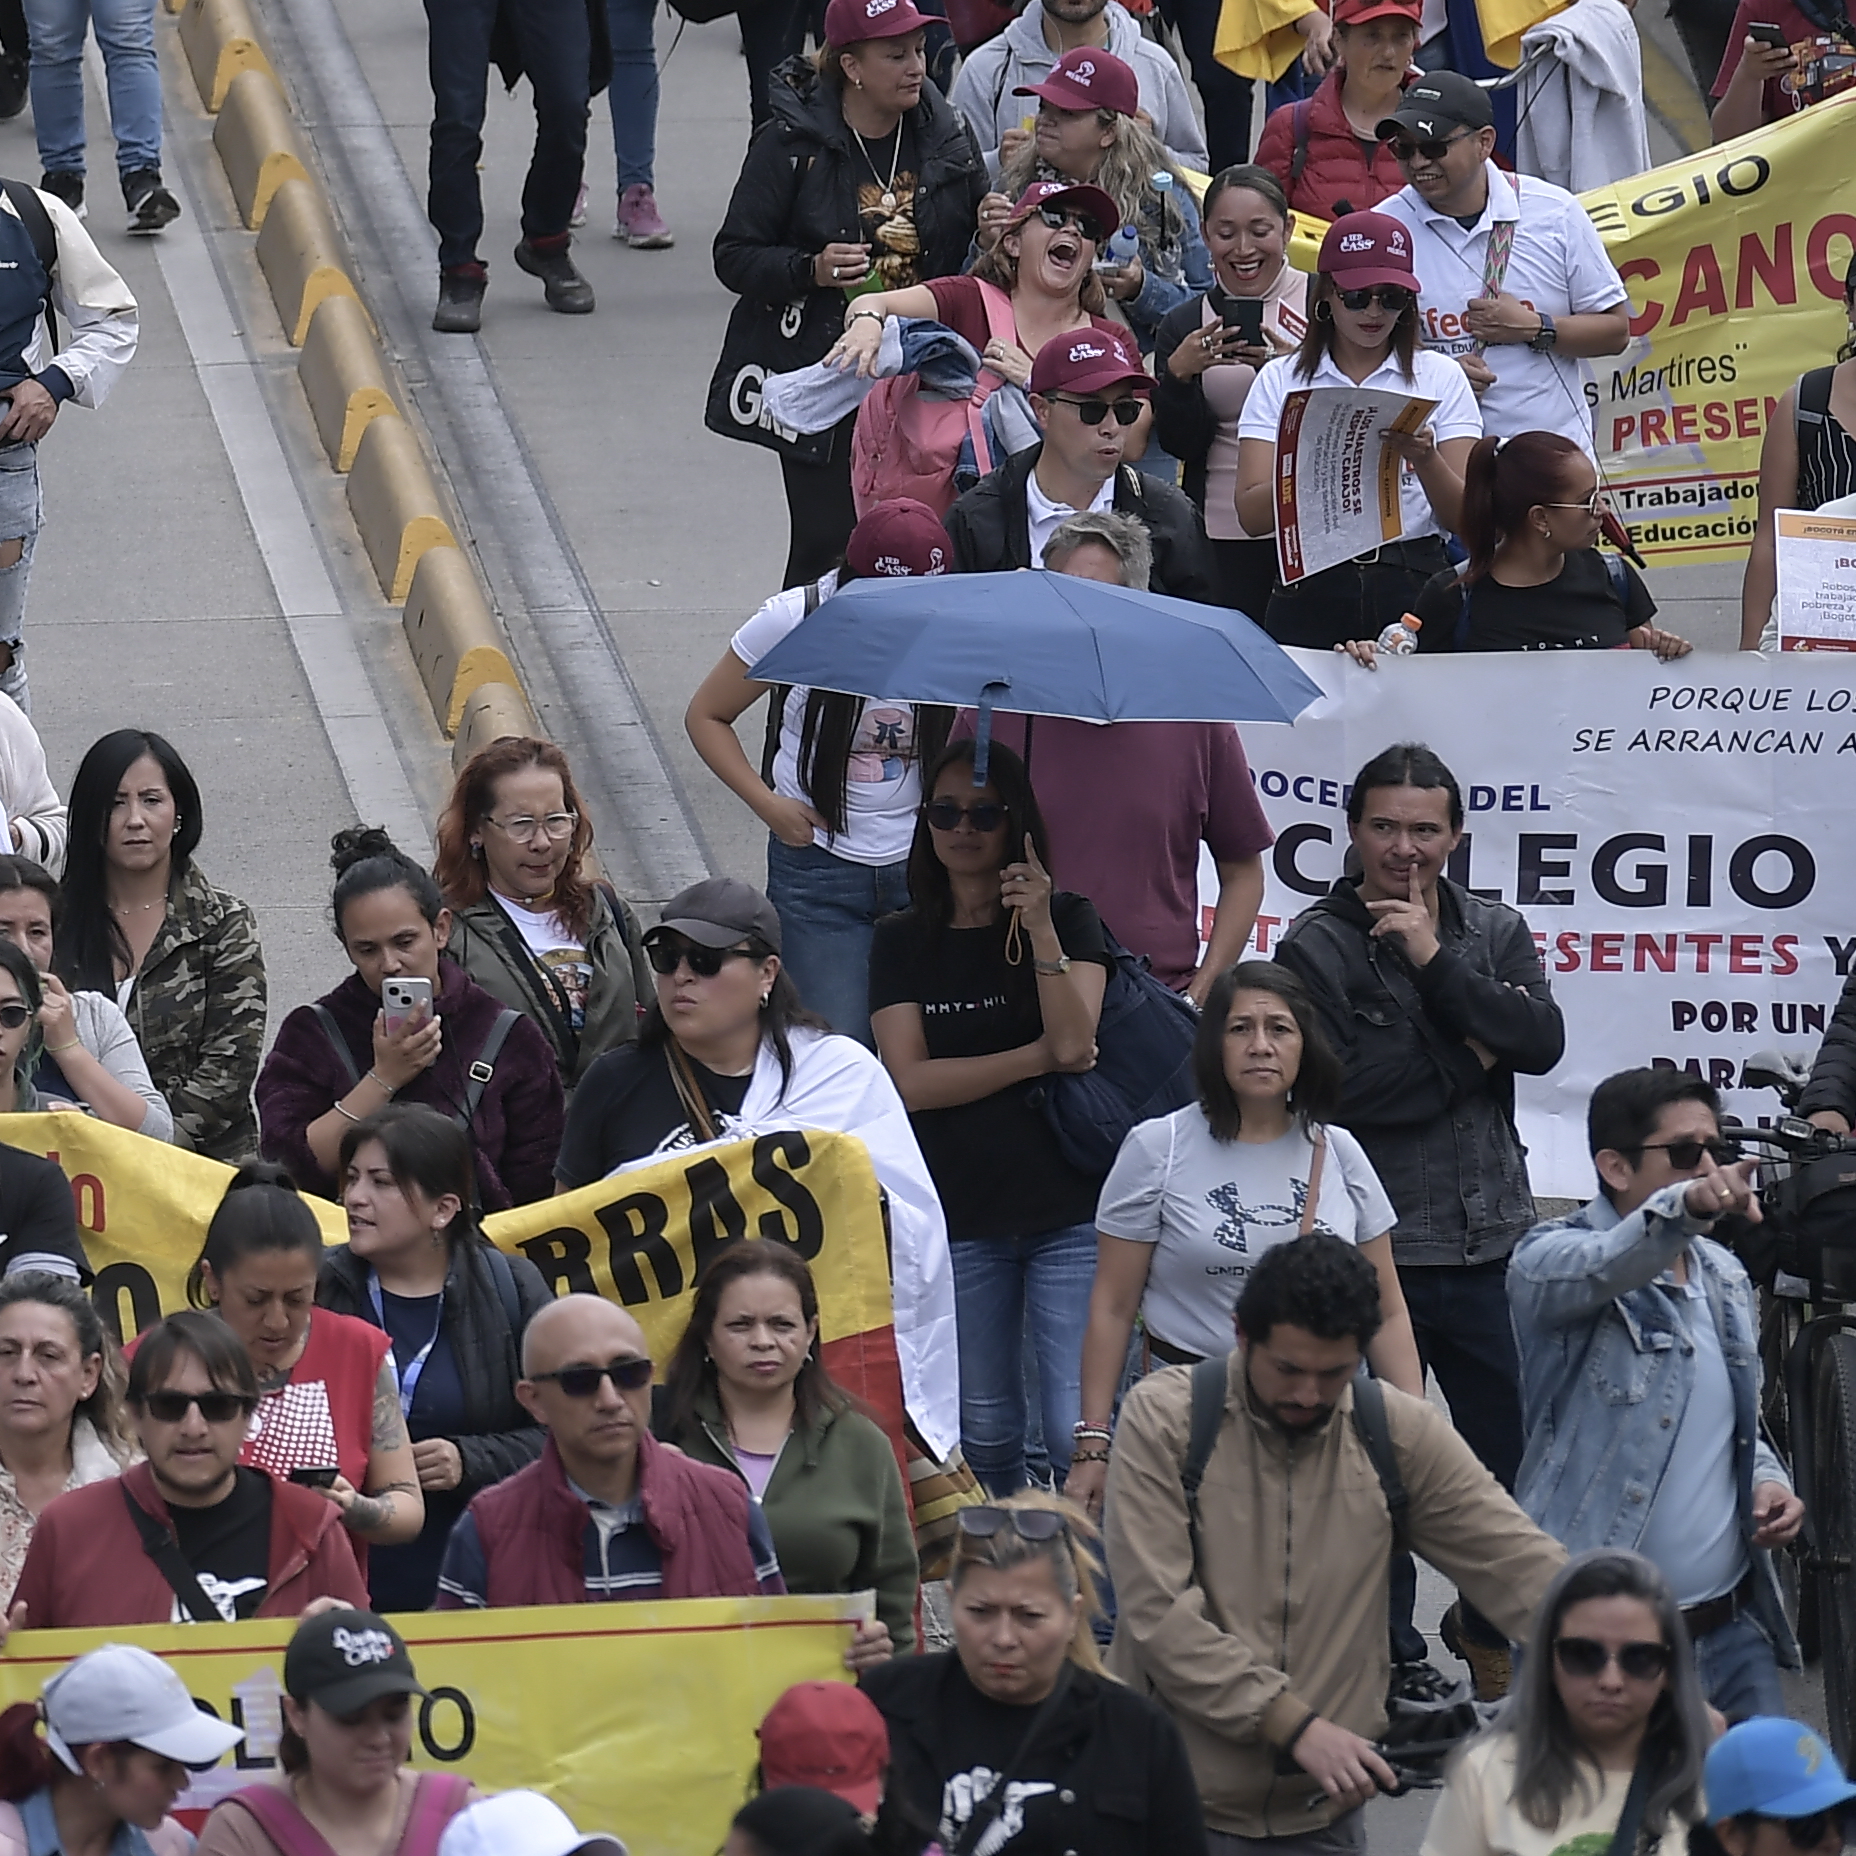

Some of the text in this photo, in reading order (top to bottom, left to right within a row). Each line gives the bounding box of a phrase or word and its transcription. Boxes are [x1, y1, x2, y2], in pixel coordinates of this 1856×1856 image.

[1361, 415, 1373, 430] LOS
[1341, 409, 1364, 513] RESPETA, CARAJO!
[1352, 431, 1367, 496] MAESTROS
[1282, 478, 1292, 504] ADE
[1353, 498, 1362, 516] SE
[1801, 601, 1844, 611] pobreza
[1647, 686, 1793, 713] PORQUE
[1572, 728, 1825, 756] SE ARRANCAN
[1468, 784, 1551, 813] DEL
[1270, 821, 1816, 910] CLEGIO
[1671, 1000, 1758, 1035] POR
